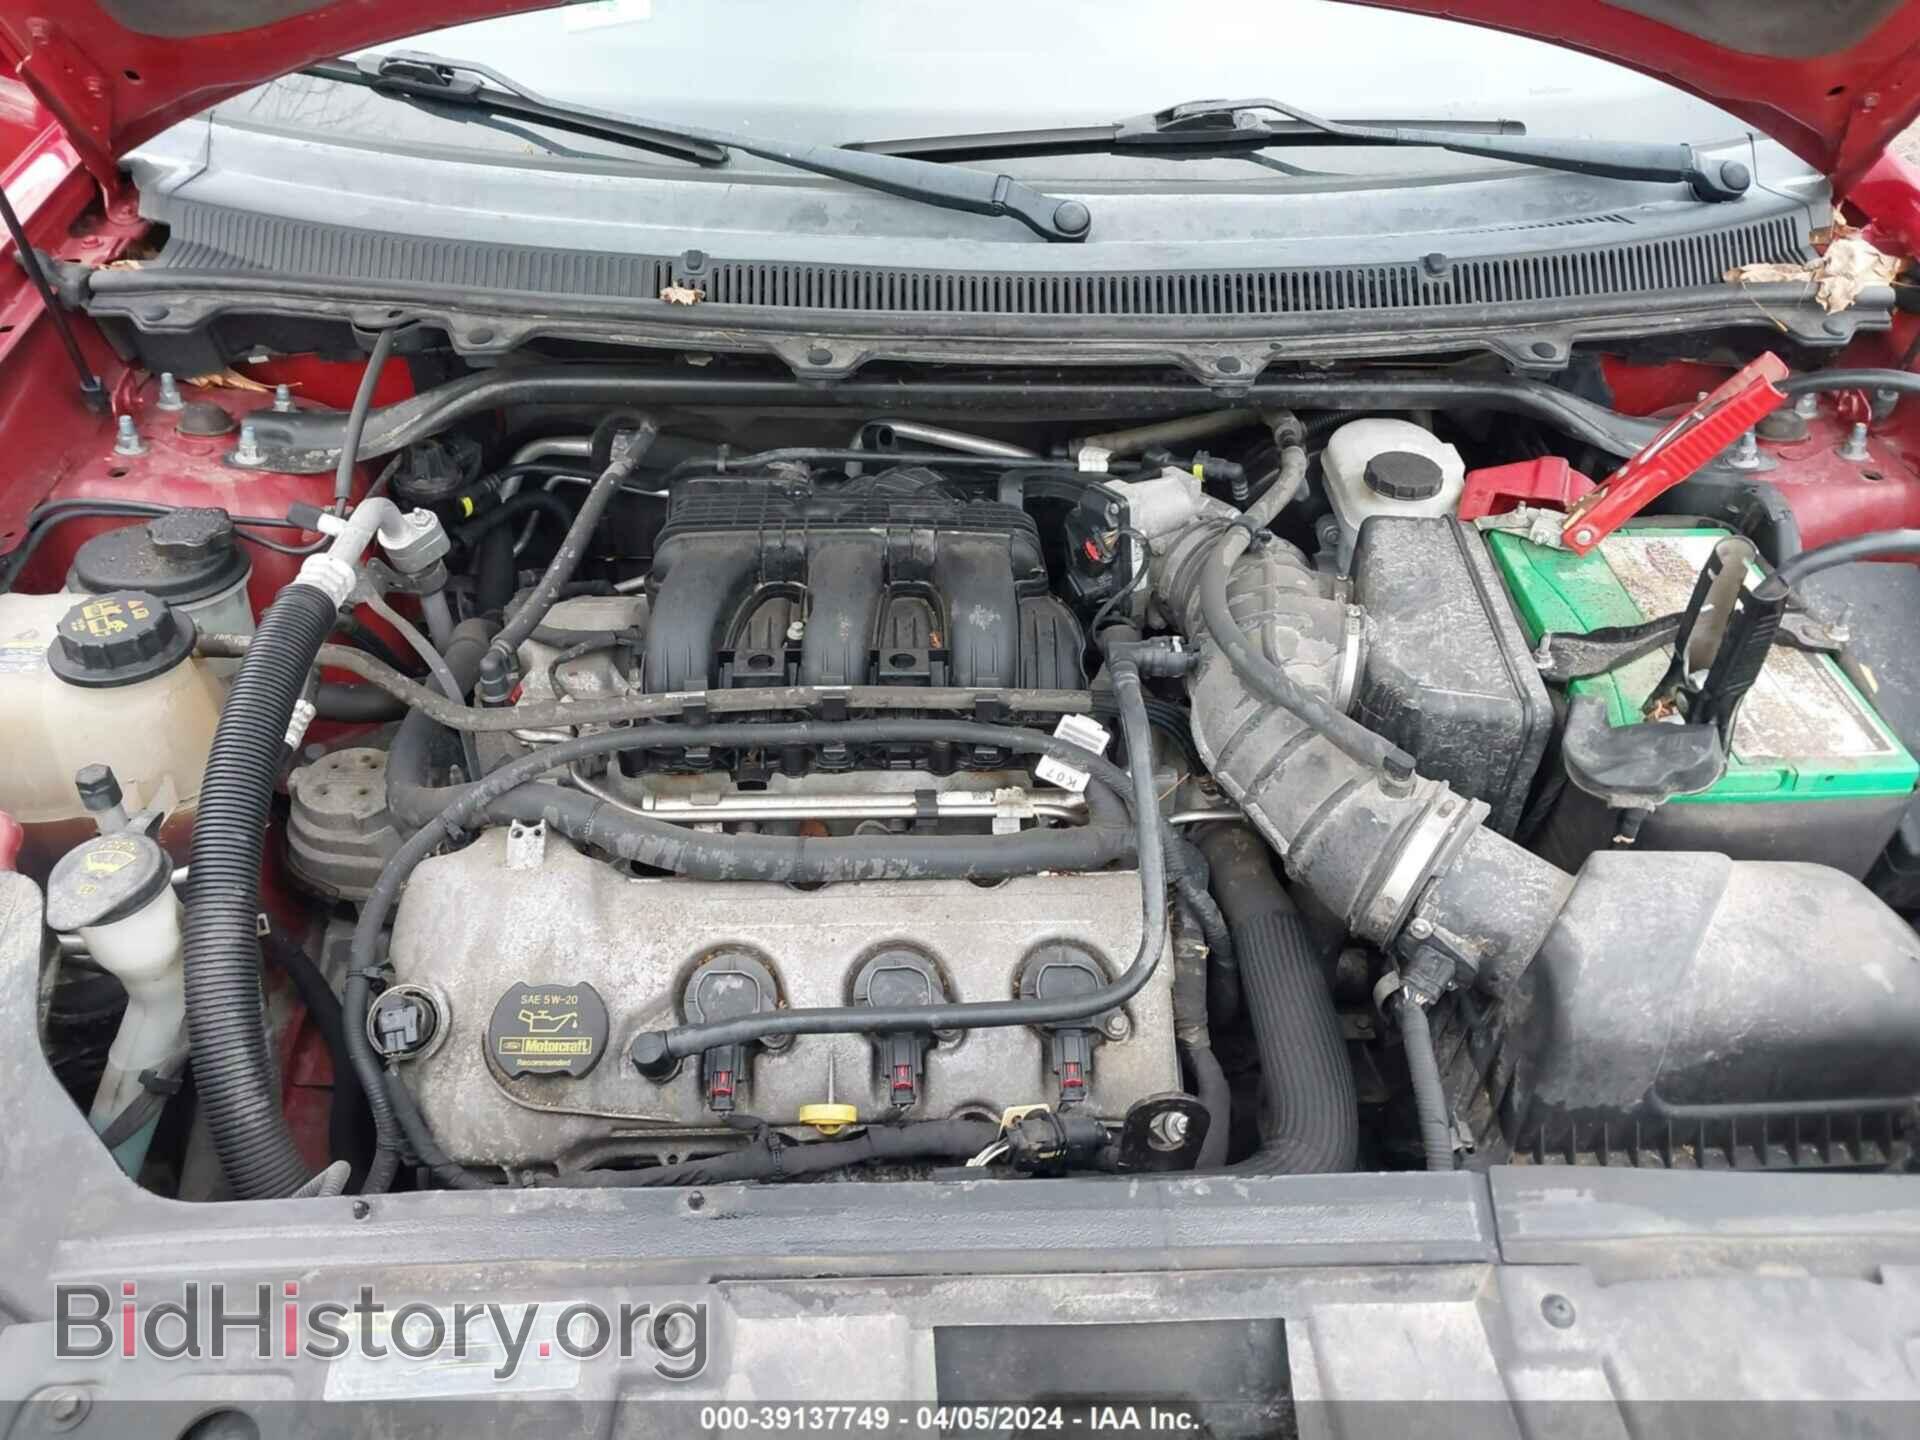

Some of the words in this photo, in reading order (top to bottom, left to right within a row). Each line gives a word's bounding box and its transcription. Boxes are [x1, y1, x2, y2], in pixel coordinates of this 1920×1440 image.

[520, 994, 541, 1005] SAE
[543, 994, 578, 1005] 5W-20
[525, 1040, 589, 1053] Motorcraft
